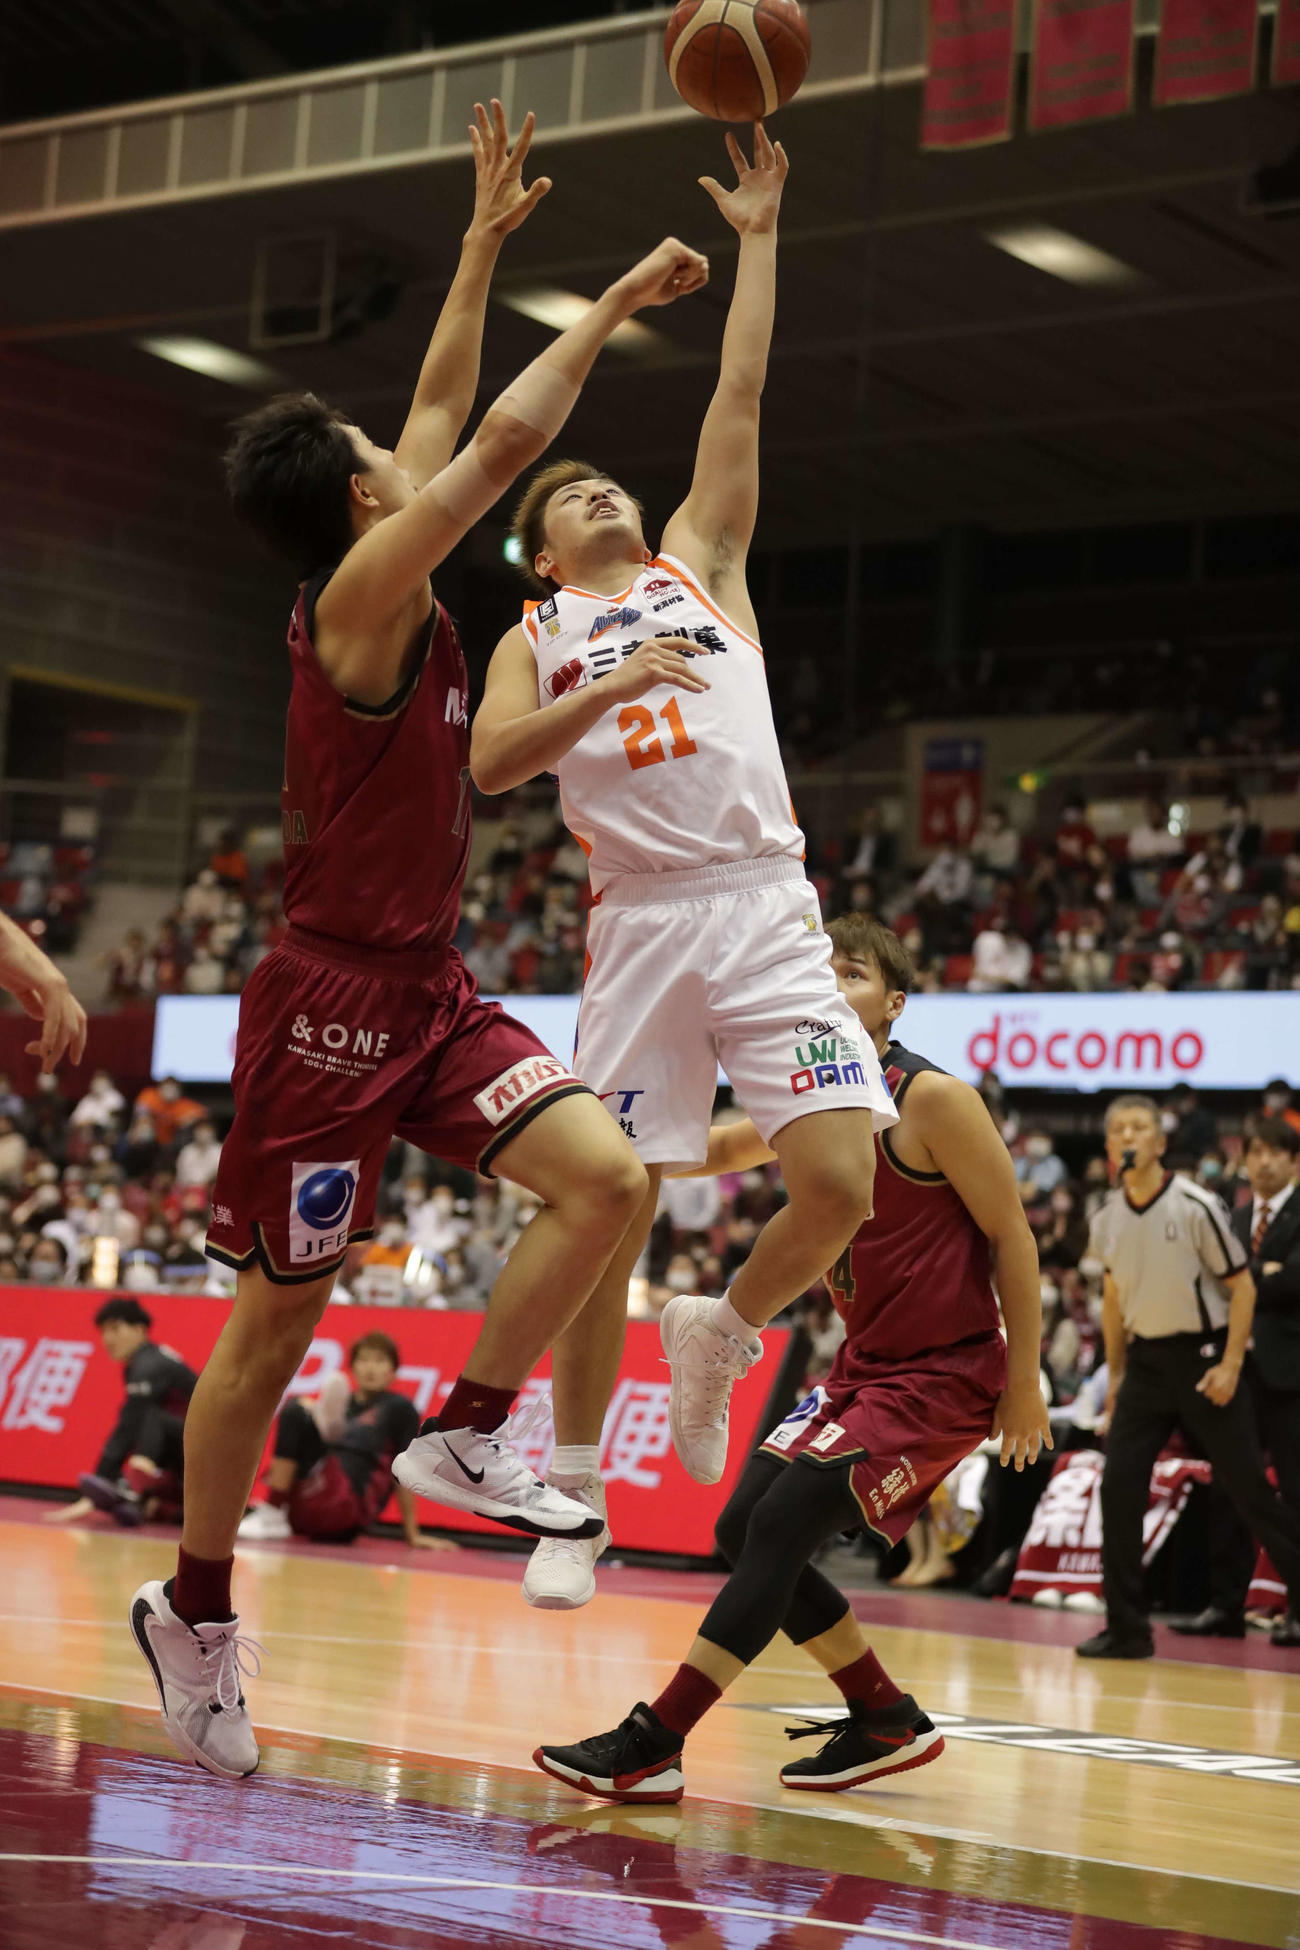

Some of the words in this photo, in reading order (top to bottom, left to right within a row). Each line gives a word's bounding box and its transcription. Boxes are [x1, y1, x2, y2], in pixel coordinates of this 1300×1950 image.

[617, 696, 698, 770] 21
[287, 1043, 325, 1061] KAWASAKI
[327, 1055, 352, 1068] BRAVE
[322, 1023, 390, 1058] ONE
[967, 1011, 1204, 1071] docomo
[296, 1230, 348, 1258] JFE
